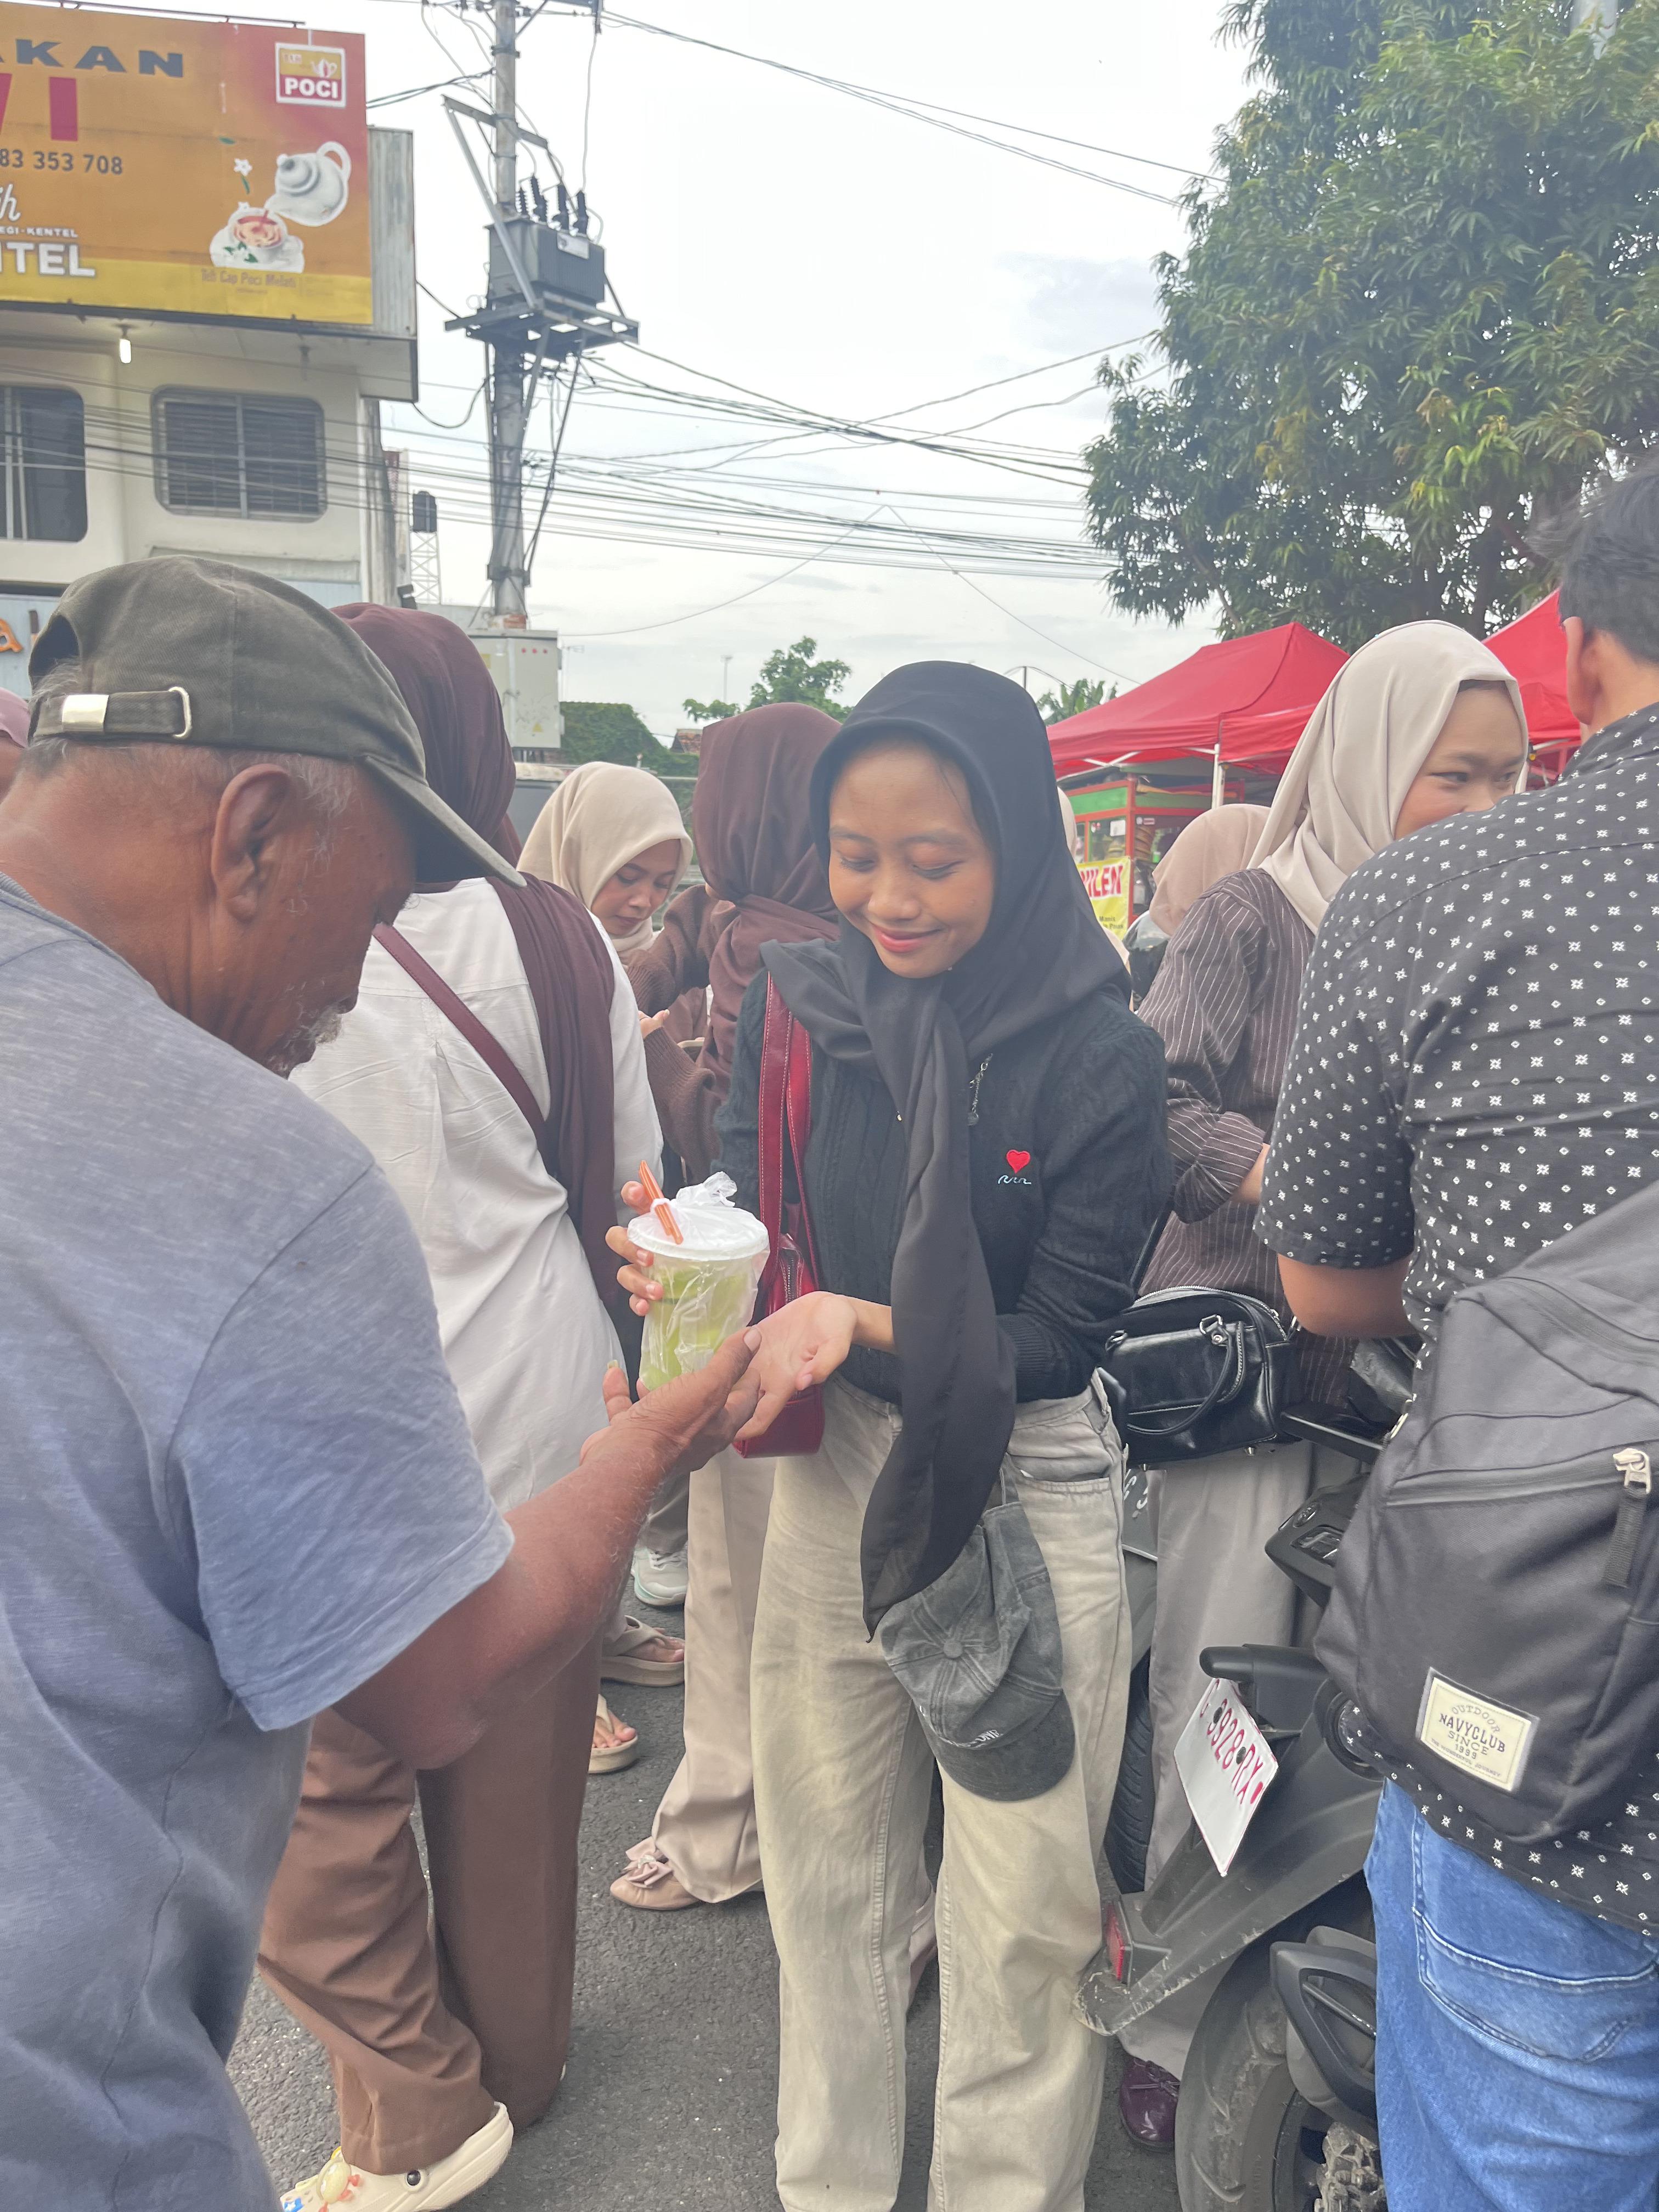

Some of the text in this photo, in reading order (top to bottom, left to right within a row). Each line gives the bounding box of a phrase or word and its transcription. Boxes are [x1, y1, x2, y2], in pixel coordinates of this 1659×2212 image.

[0, 38, 183, 78] KAN
[284, 77, 338, 99] POCI
[33, 150, 74, 171] 353
[83, 154, 123, 175] 708
[0, 242, 95, 276] TEL
[1438, 1712, 1506, 1753] NAVYCLUB
[1451, 1705, 1500, 1733] OUTDOOR
[1448, 1730, 1489, 1756] SINCE
